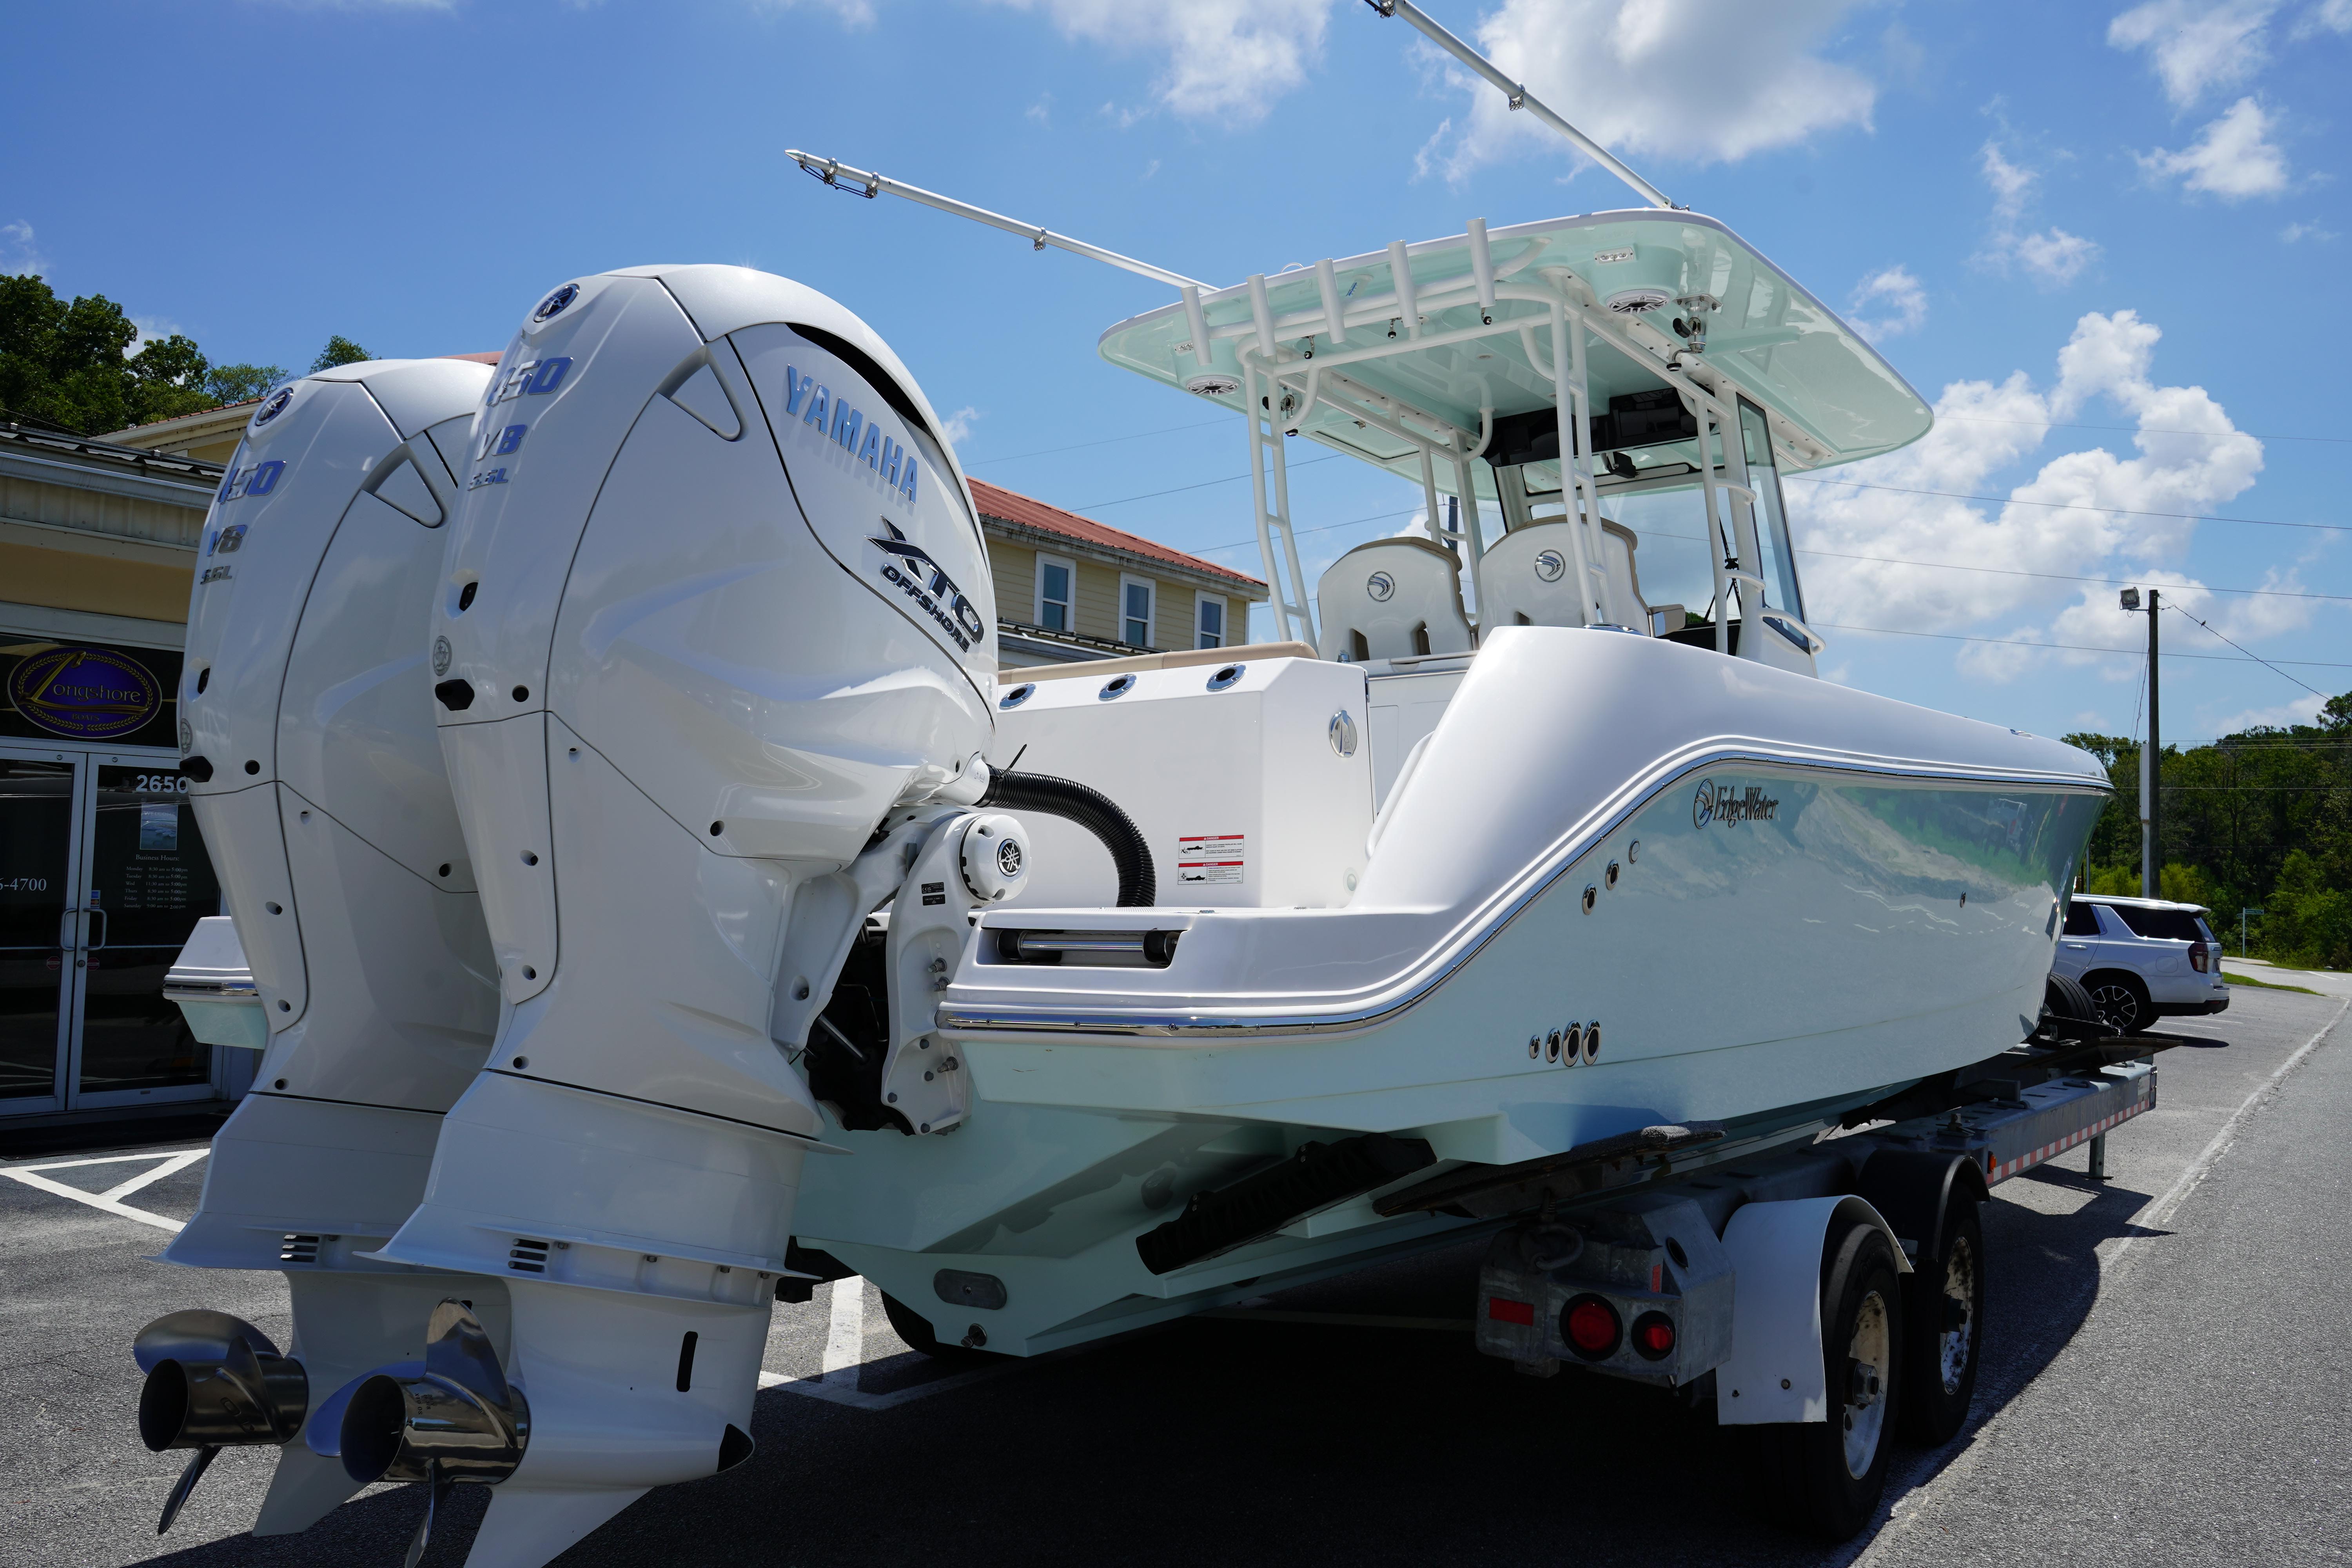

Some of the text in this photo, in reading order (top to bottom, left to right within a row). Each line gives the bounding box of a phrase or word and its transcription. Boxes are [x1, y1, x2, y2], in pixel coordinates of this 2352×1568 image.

[475, 424, 527, 462] V8
[786, 364, 918, 506] YAMAHA
[207, 524, 248, 557] V8
[864, 514, 984, 645] XTO
[880, 563, 971, 655] OFFSHORE
[17, 650, 149, 715] Longshore
[72, 713, 100, 722] BOATS
[136, 775, 189, 793] 2650
[1713, 786, 1779, 828] EdgeWater
